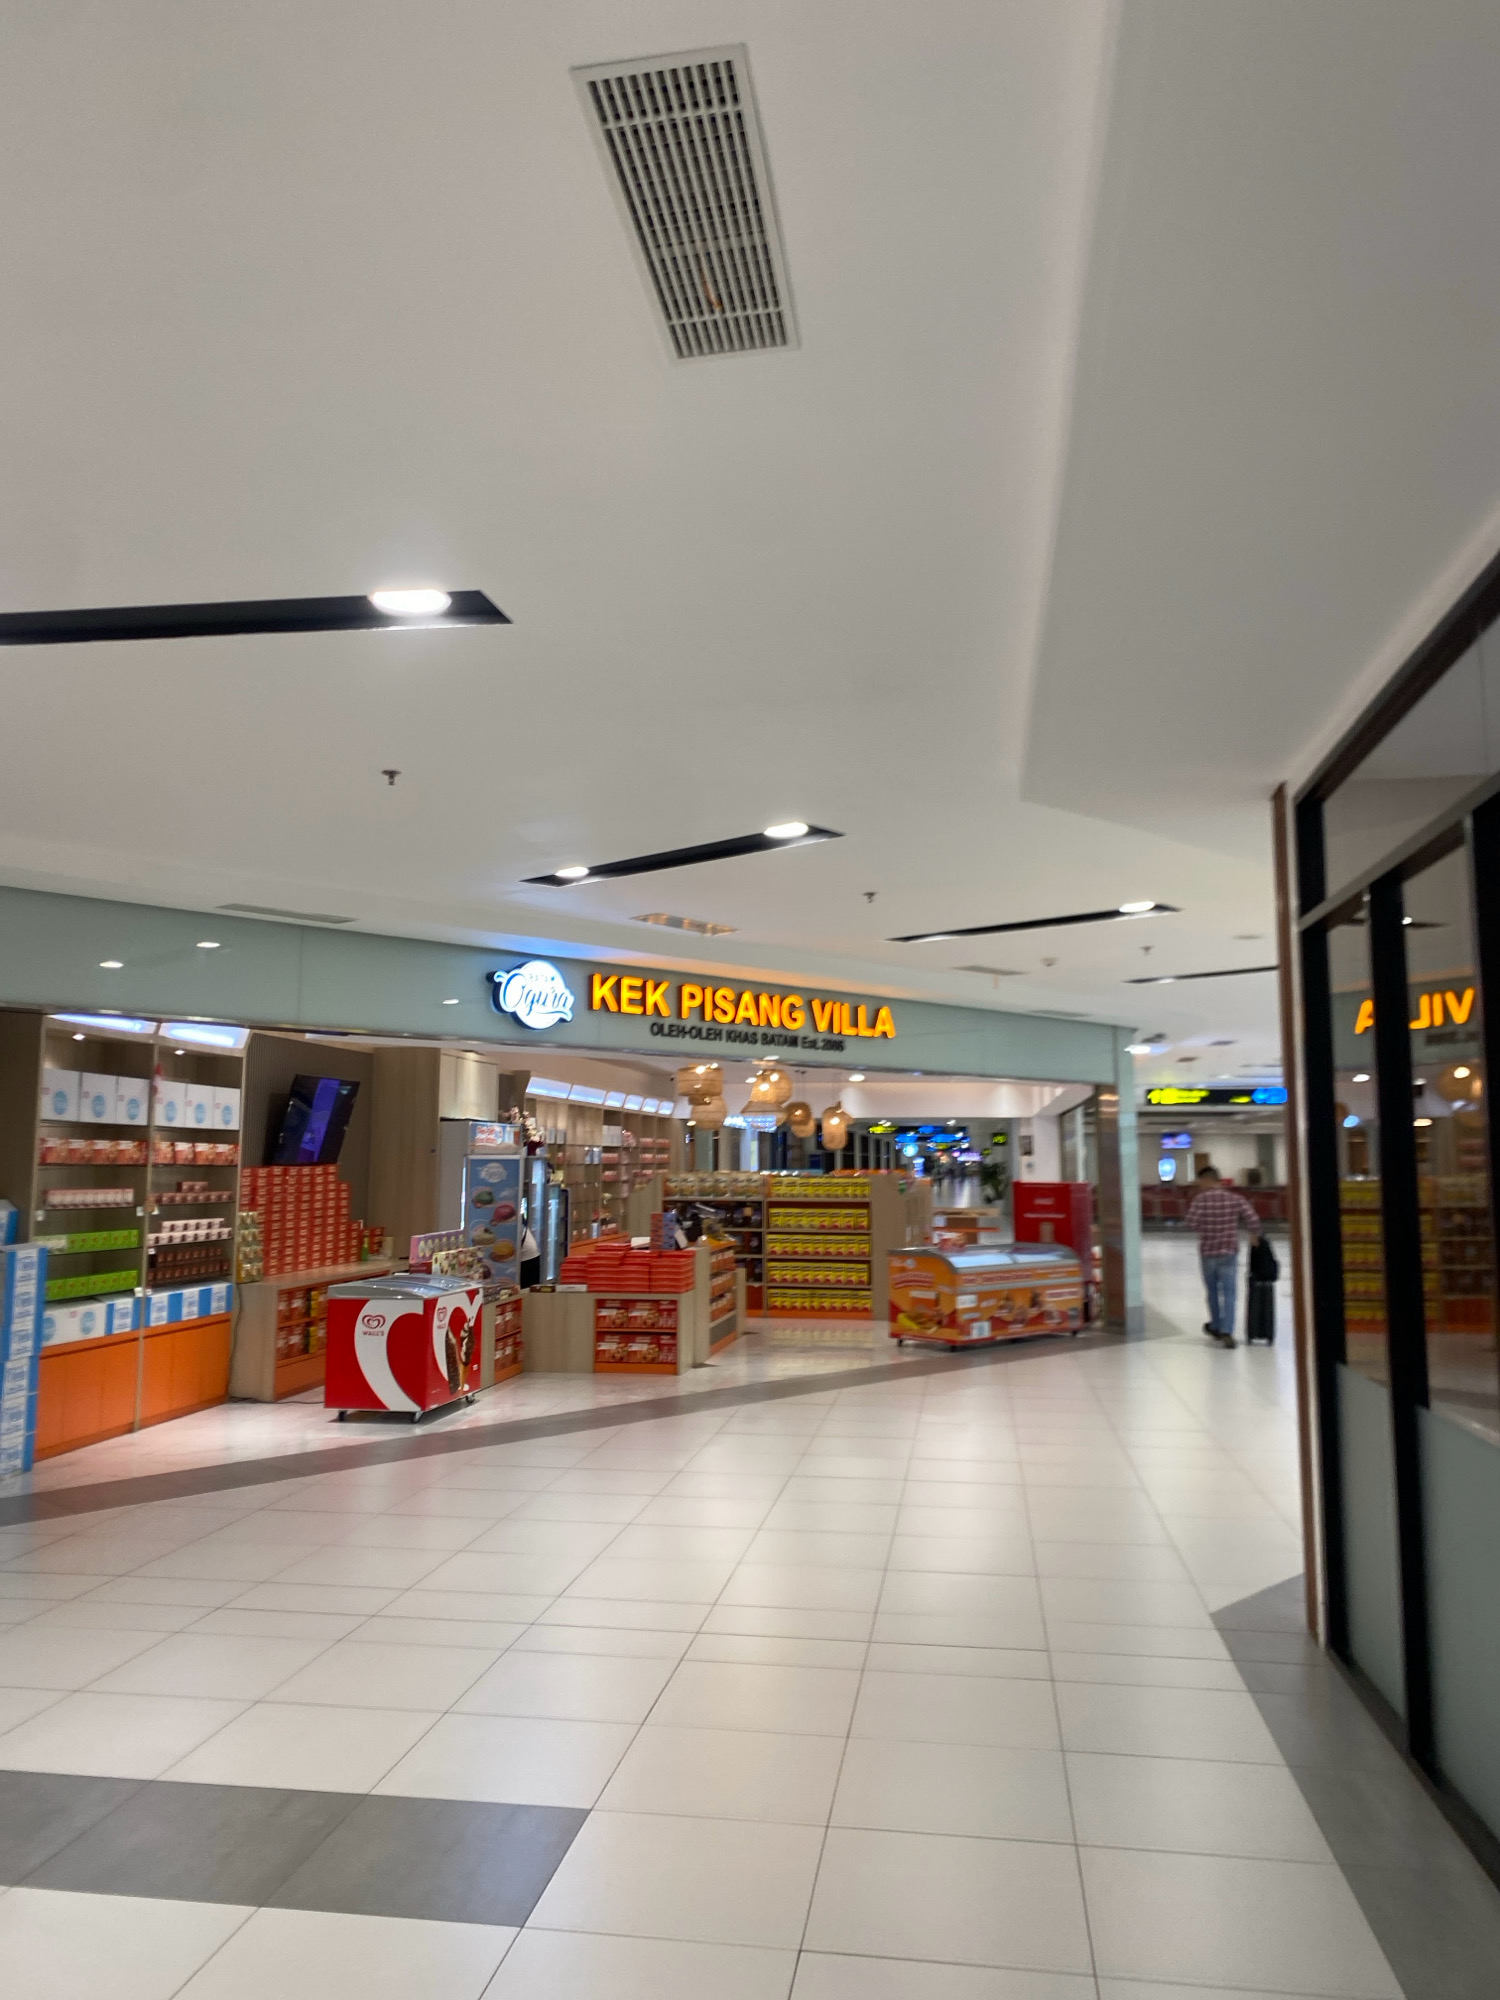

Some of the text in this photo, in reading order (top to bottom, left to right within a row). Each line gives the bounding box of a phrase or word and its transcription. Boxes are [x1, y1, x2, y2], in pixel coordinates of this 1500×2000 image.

[591, 972, 896, 1038] KEK PISANG VILLA
[651, 1022, 722, 1042] OLEH-OLEH
[725, 1029, 758, 1045] KHAS
[761, 1032, 799, 1048] BATAM
